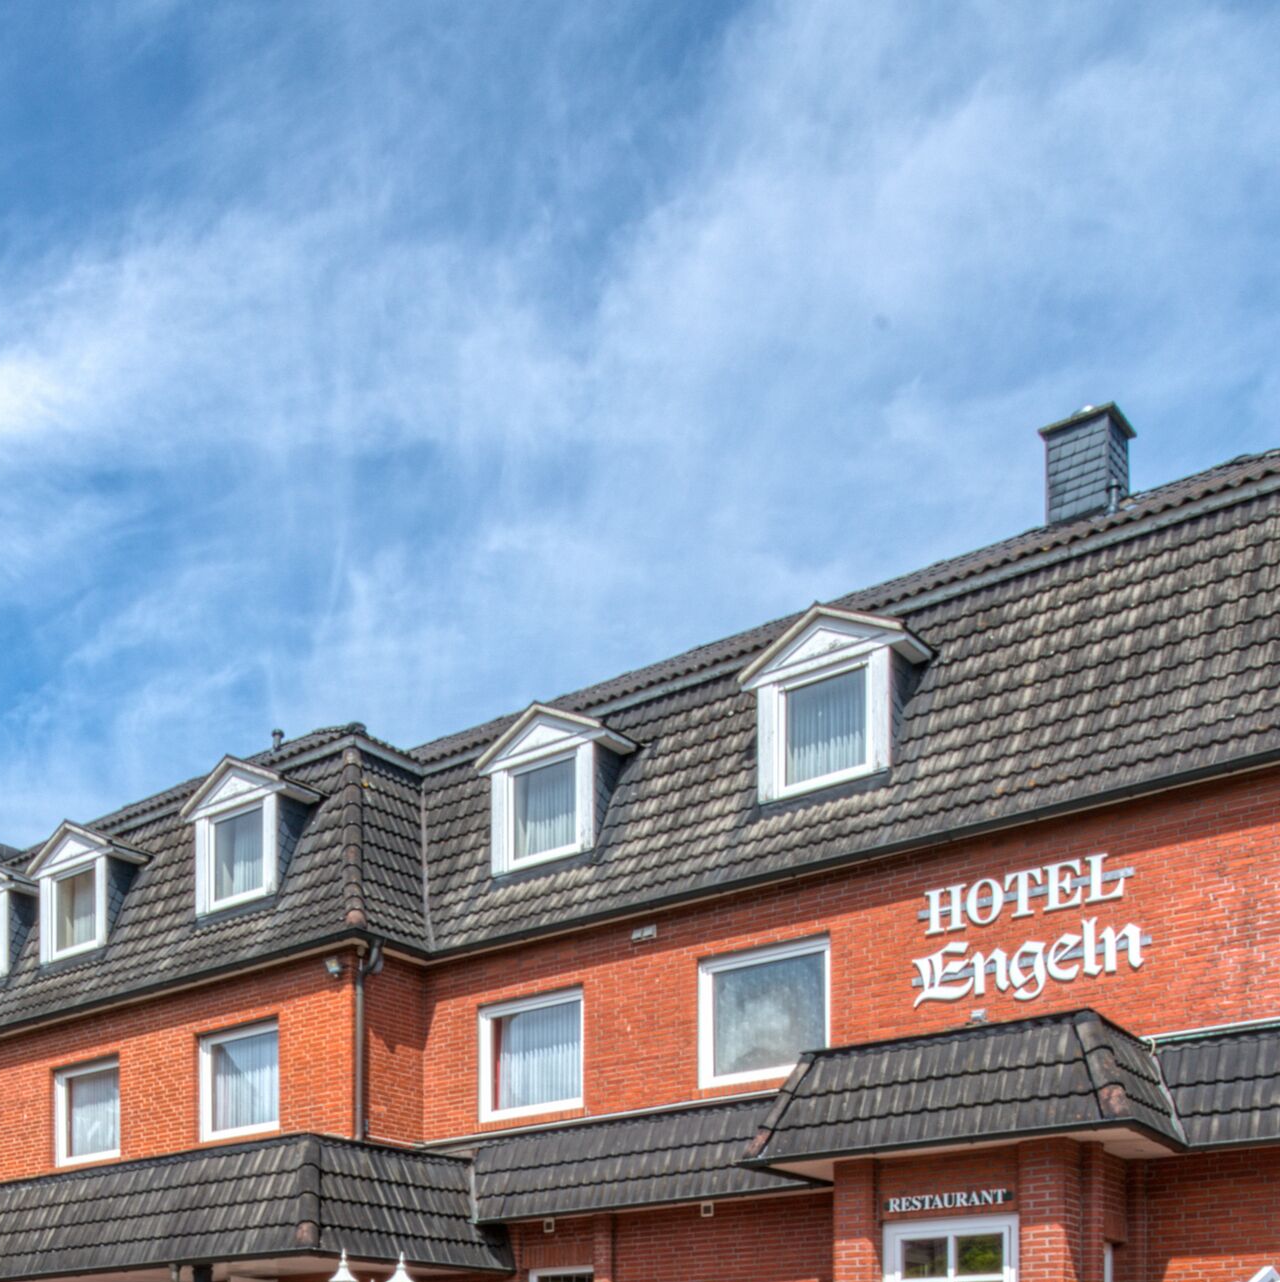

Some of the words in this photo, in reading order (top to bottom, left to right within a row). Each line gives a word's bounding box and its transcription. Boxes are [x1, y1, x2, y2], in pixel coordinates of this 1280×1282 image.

[924, 853, 1125, 936] HOTEL
[911, 916, 1144, 1009] Engeln
[888, 1188, 1007, 1213] RESTAURANT
